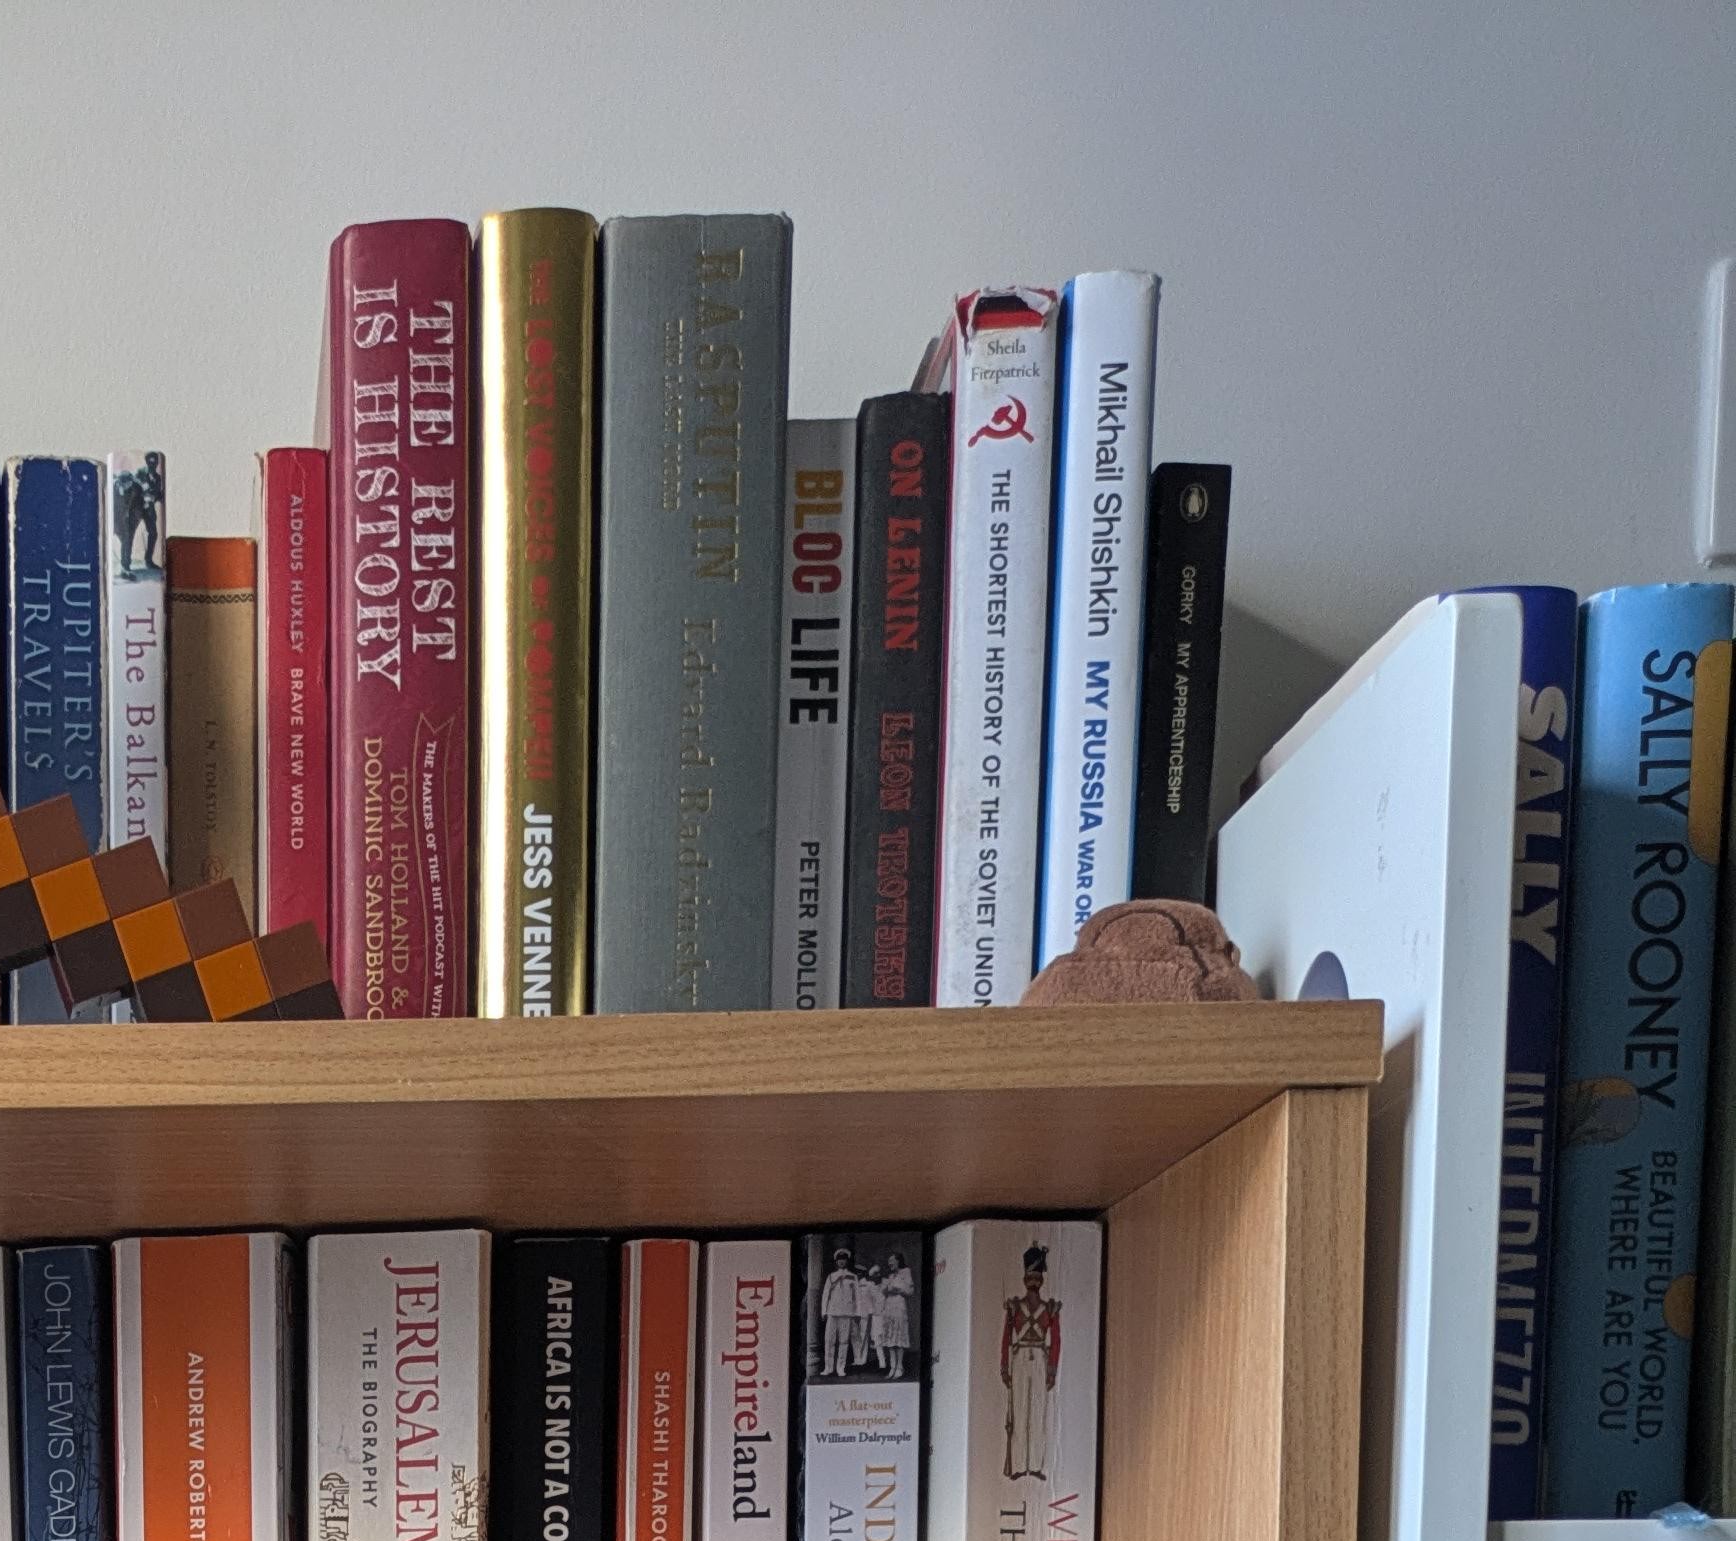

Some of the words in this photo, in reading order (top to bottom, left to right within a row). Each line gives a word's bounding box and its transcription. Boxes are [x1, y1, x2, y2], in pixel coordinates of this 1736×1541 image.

[352, 280, 398, 349] IS
[986, 339, 1026, 355] Sheila
[410, 300, 455, 449] THE
[970, 362, 1041, 382] Fitzpatrick
[1097, 361, 1129, 484] Mikhail
[290, 494, 304, 572] ALDOUS
[354, 375, 402, 693] HISTORY
[411, 479, 456, 661] REST
[1088, 492, 1123, 638] Shishkin
[290, 582, 304, 654] HUXLEY
[1180, 566, 1195, 624] GORKY
[22, 570, 53, 771] TRAVELS
[55, 560, 93, 781] JUPITER'S
[290, 668, 304, 726] BRAVE
[1176, 642, 1190, 670] MY
[290, 733, 304, 775] NEW
[1168, 676, 1188, 814] APPRENTICESHIP
[1638, 648, 1695, 816] SALLY
[290, 780, 304, 850] WORLD
[1624, 843, 1688, 1111] ROONEY
[362, 1327, 378, 1372] THE
[719, 1275, 772, 1522] Empireland
[362, 1382, 379, 1509] BIOGRAPHY
[815, 1431, 854, 1443] William
[859, 1431, 911, 1445] Dalrymple
